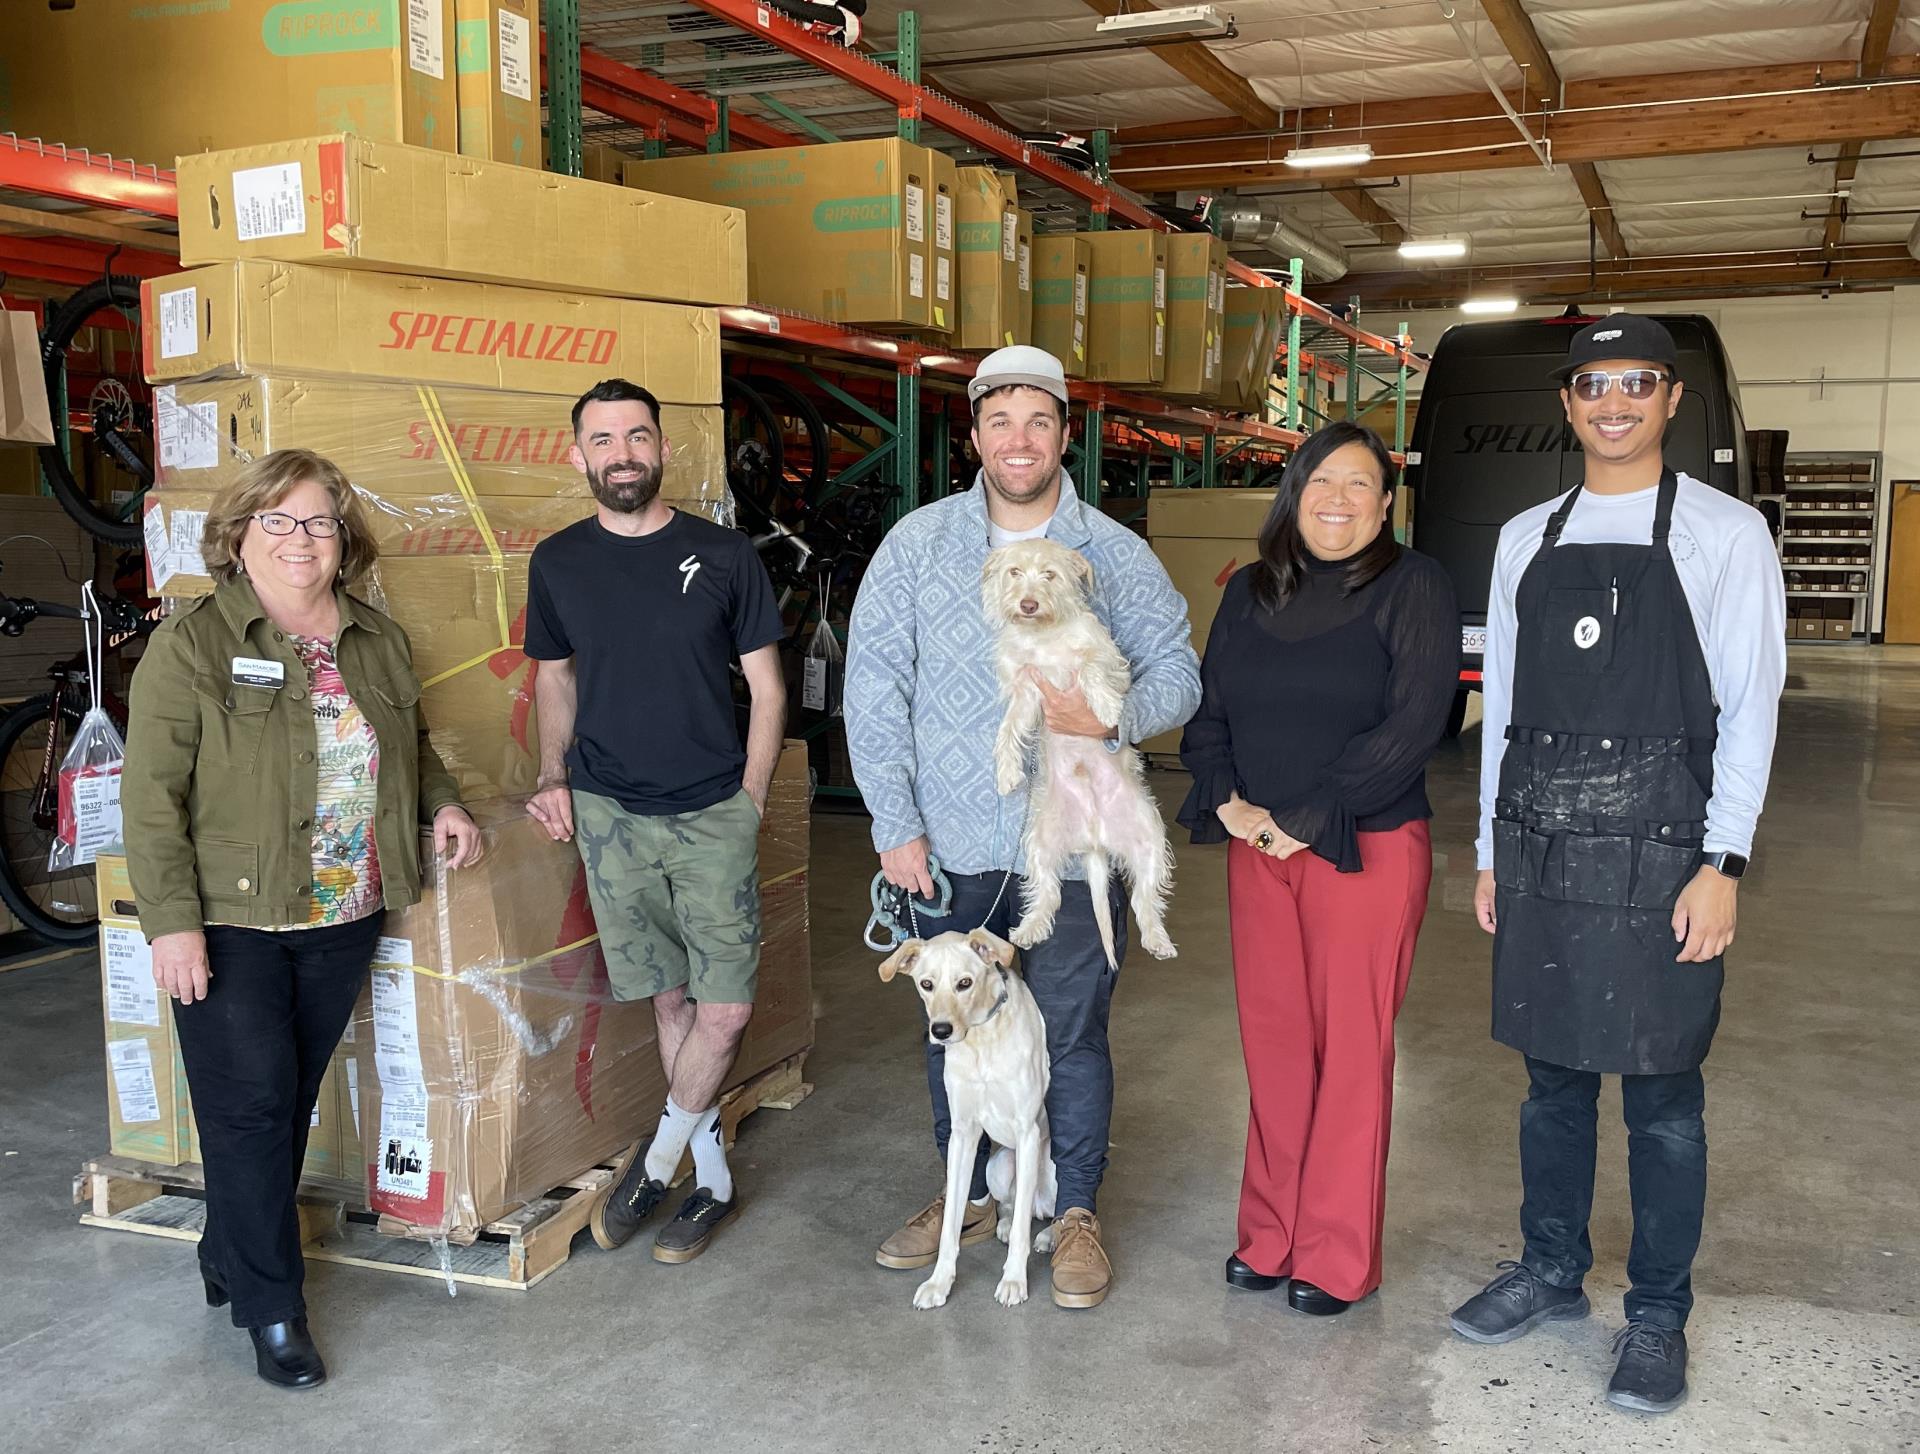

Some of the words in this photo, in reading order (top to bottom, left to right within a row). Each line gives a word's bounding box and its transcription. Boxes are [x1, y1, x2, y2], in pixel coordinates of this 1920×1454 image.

[277, 8, 382, 40] RIPROCK
[823, 202, 890, 224] RIPROCK
[379, 311, 618, 365] SPECIALIZED
